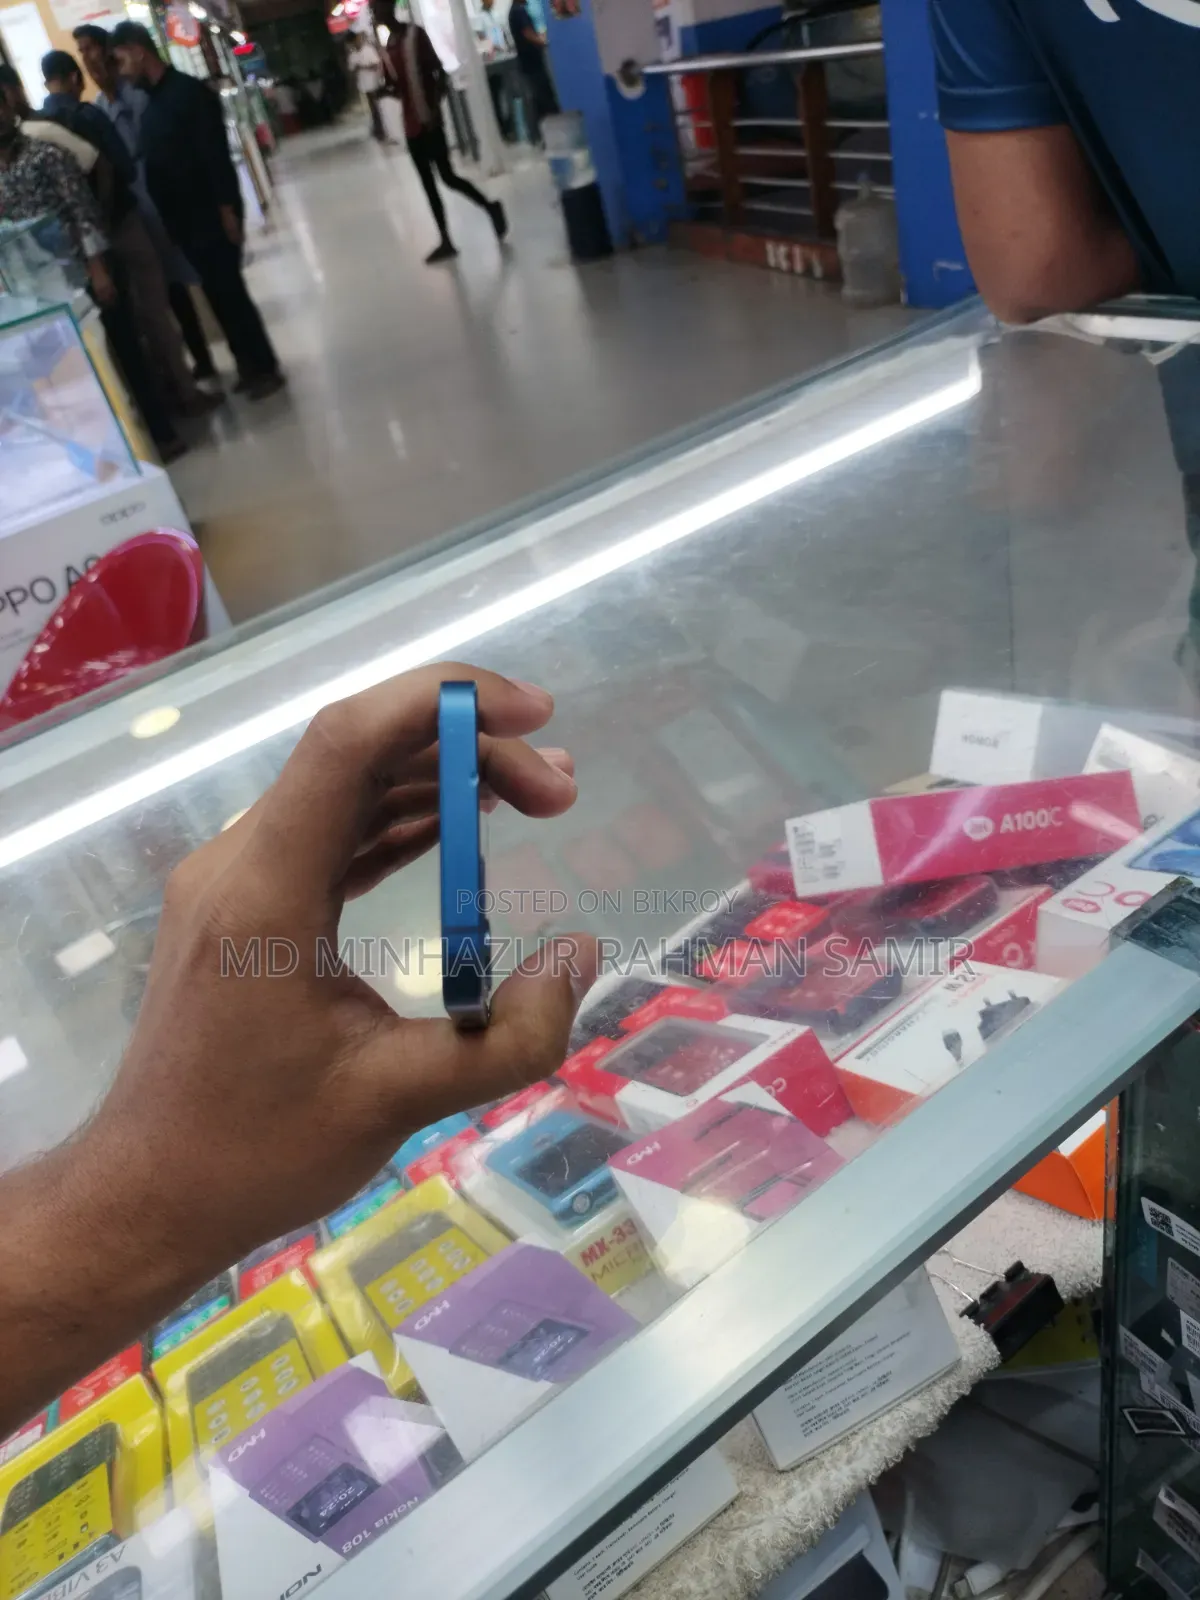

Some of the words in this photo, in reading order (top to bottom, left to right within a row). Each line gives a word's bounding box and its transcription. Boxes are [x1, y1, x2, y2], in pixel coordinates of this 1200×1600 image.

[1000, 806, 1063, 835] A100C
[414, 1300, 450, 1331] HMD
[227, 1427, 266, 1462] HMD
[374, 1495, 419, 1528] Nokia
[341, 1528, 372, 1554] 108
